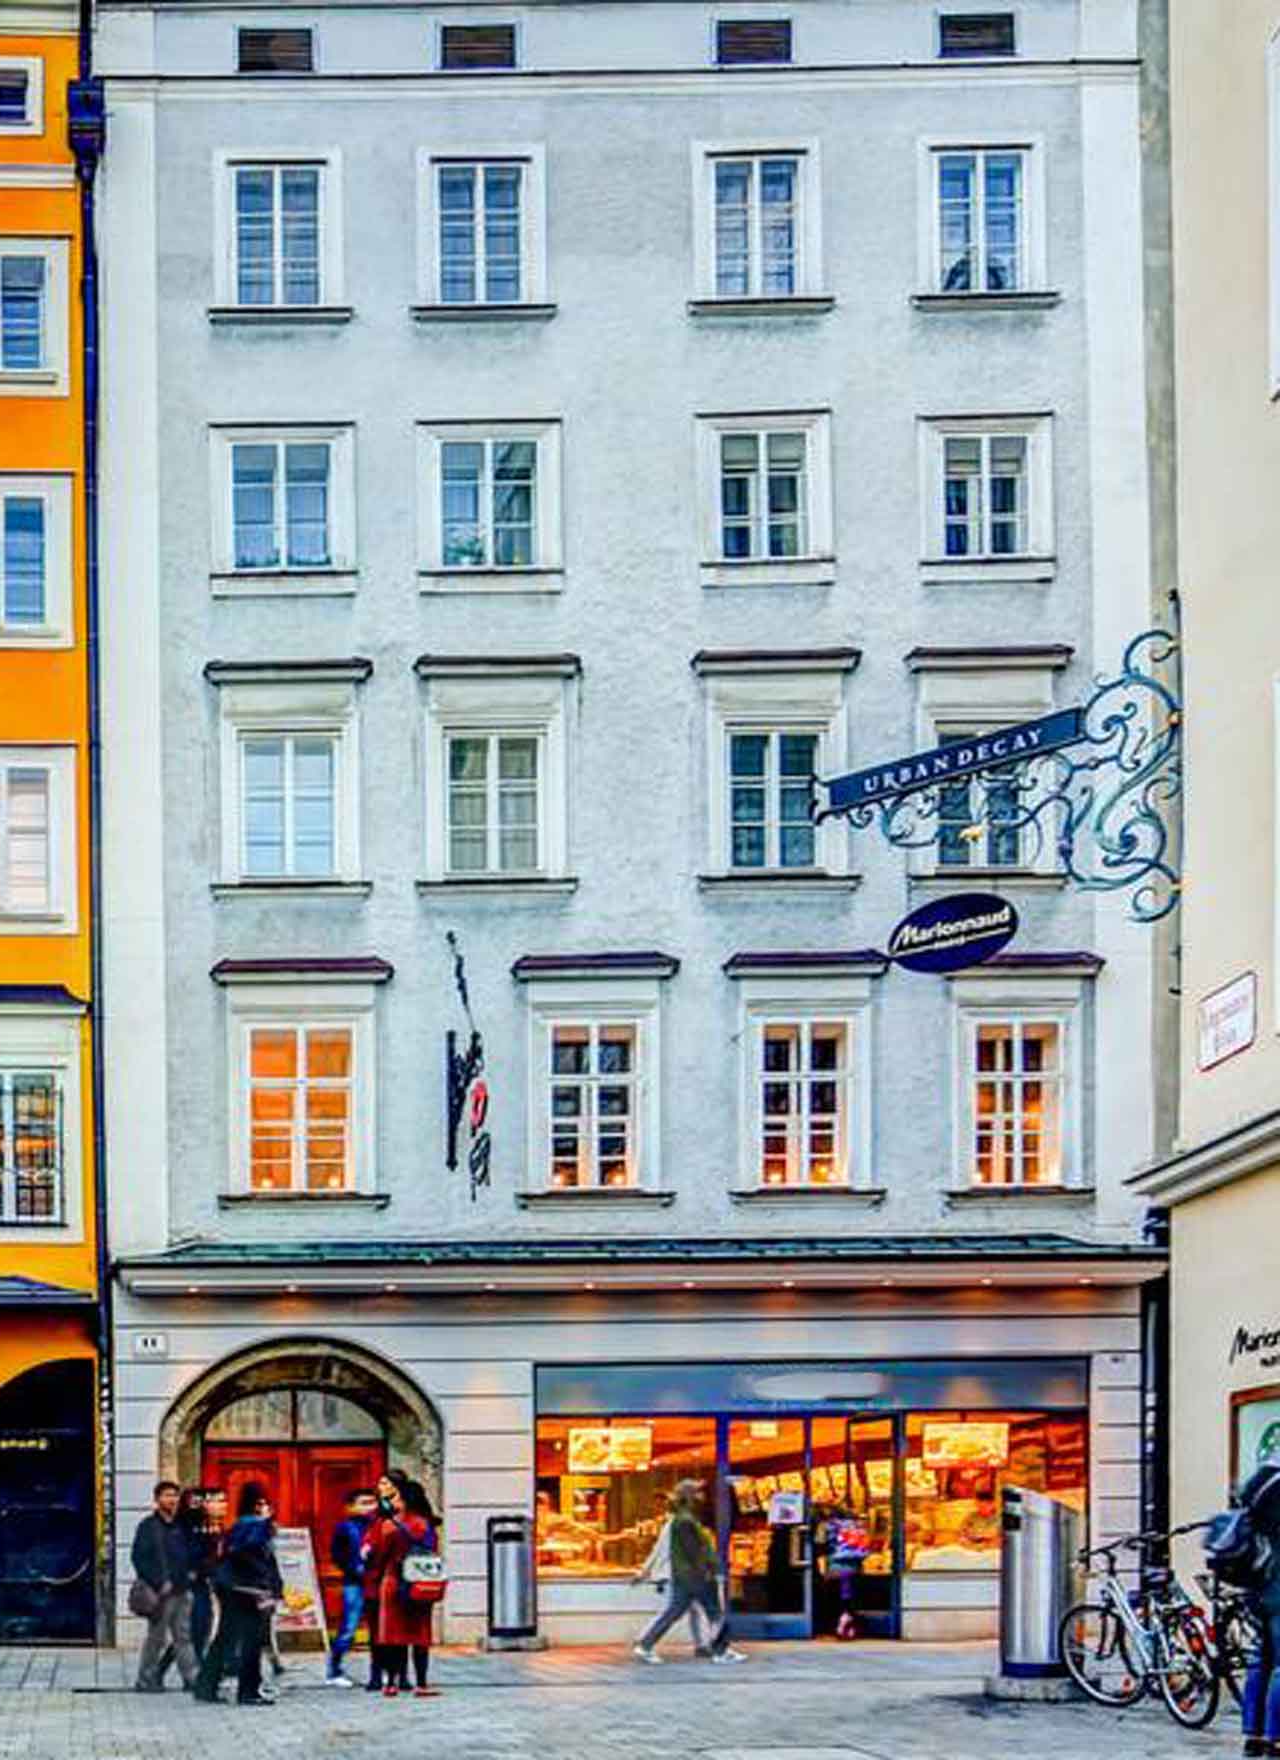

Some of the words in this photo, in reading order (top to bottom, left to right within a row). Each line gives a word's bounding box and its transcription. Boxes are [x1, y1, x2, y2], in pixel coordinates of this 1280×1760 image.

[862, 754, 950, 793] URBAN
[956, 727, 1043, 767] DECAY
[891, 904, 1011, 954] Marionnaud
